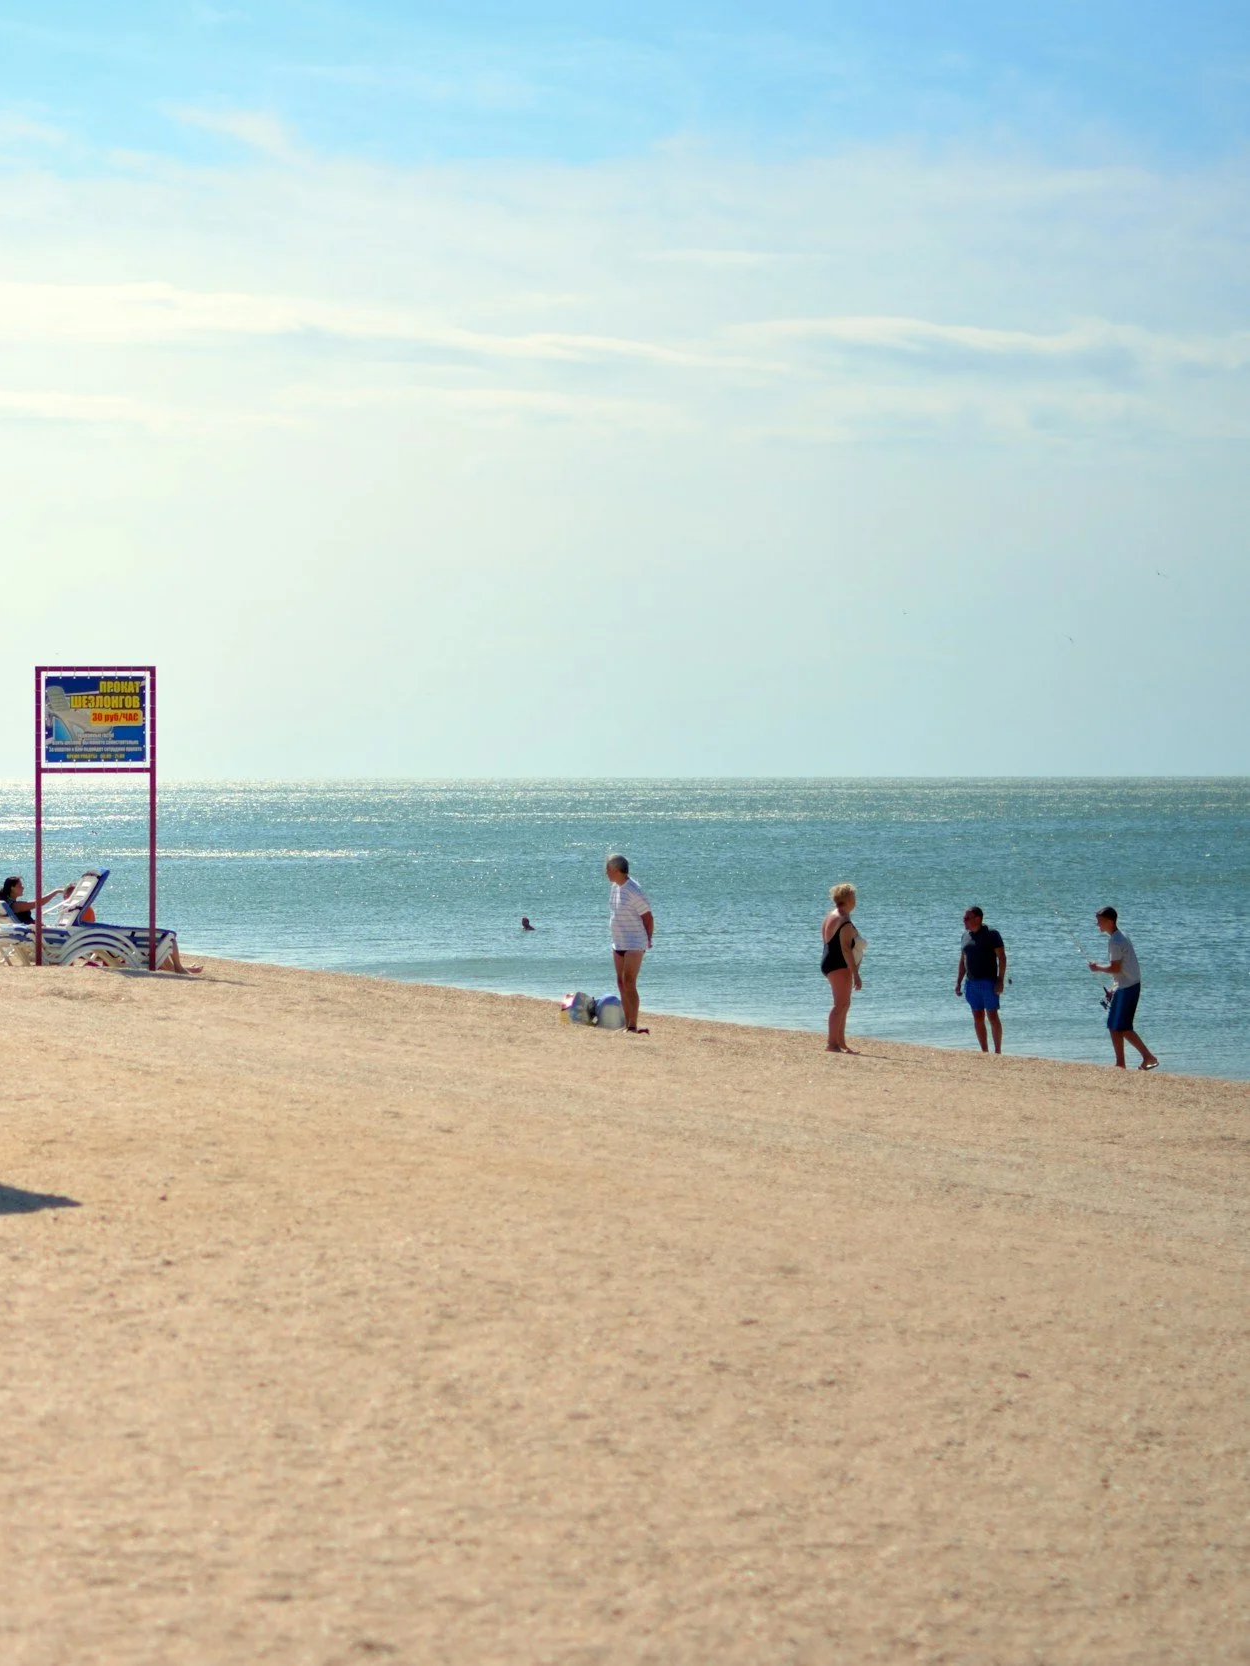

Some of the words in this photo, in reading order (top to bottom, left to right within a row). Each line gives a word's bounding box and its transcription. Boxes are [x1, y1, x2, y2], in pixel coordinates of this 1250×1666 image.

[100, 681, 141, 693] ПРОКАТ
[70, 696, 140, 708] ШЕЗЛОНГОВ
[92, 712, 103, 722] 30
